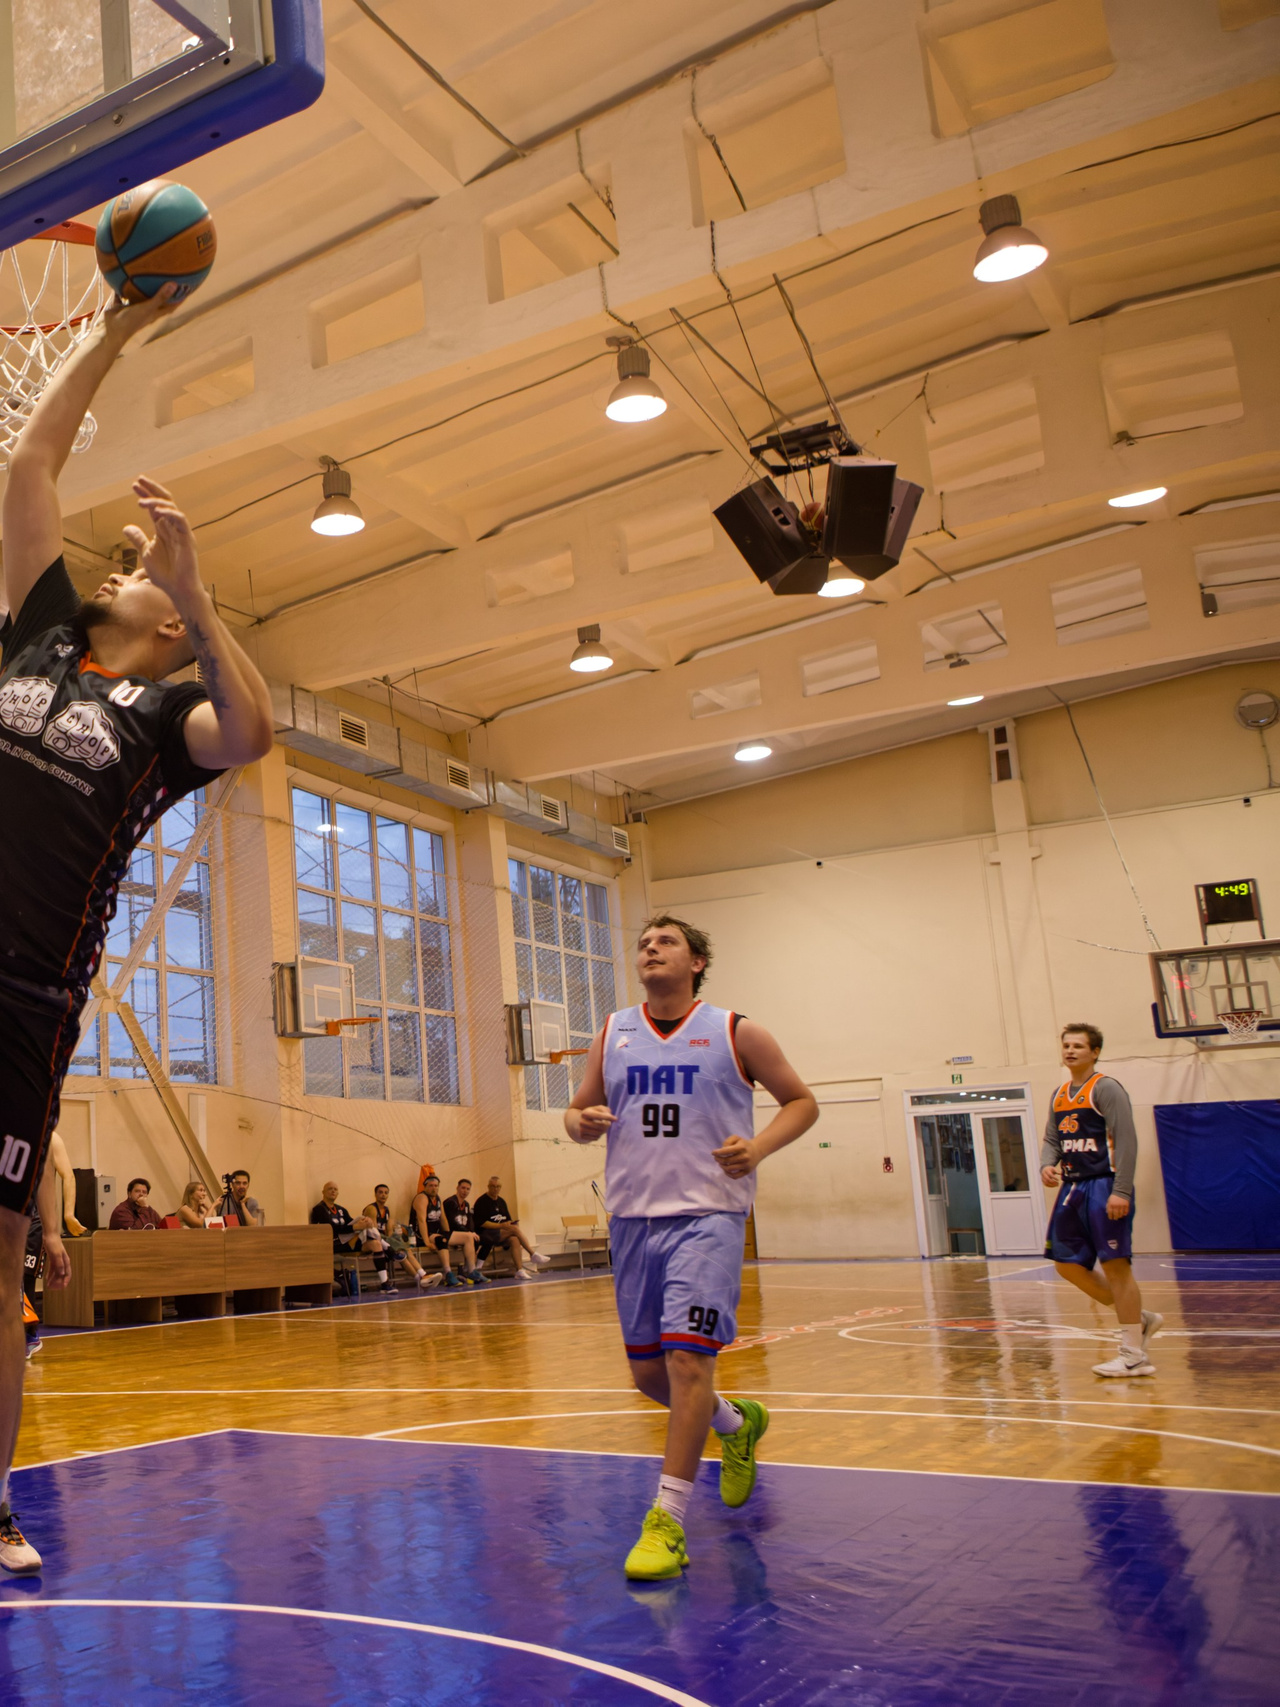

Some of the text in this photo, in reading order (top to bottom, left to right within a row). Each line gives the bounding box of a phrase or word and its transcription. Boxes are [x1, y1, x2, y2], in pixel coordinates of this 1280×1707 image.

[108, 679, 145, 707] 10
[10, 745, 24, 758] IN
[21, 750, 49, 771] GOOD
[47, 763, 95, 796] COMPANY
[1215, 883, 1249, 897] 4:49
[626, 1065, 700, 1095] ПАТ
[642, 1103, 680, 1138] 99
[1061, 1138, 1098, 1153] РМА
[24, 1254, 37, 1269] 33
[688, 1305, 720, 1336] 99
